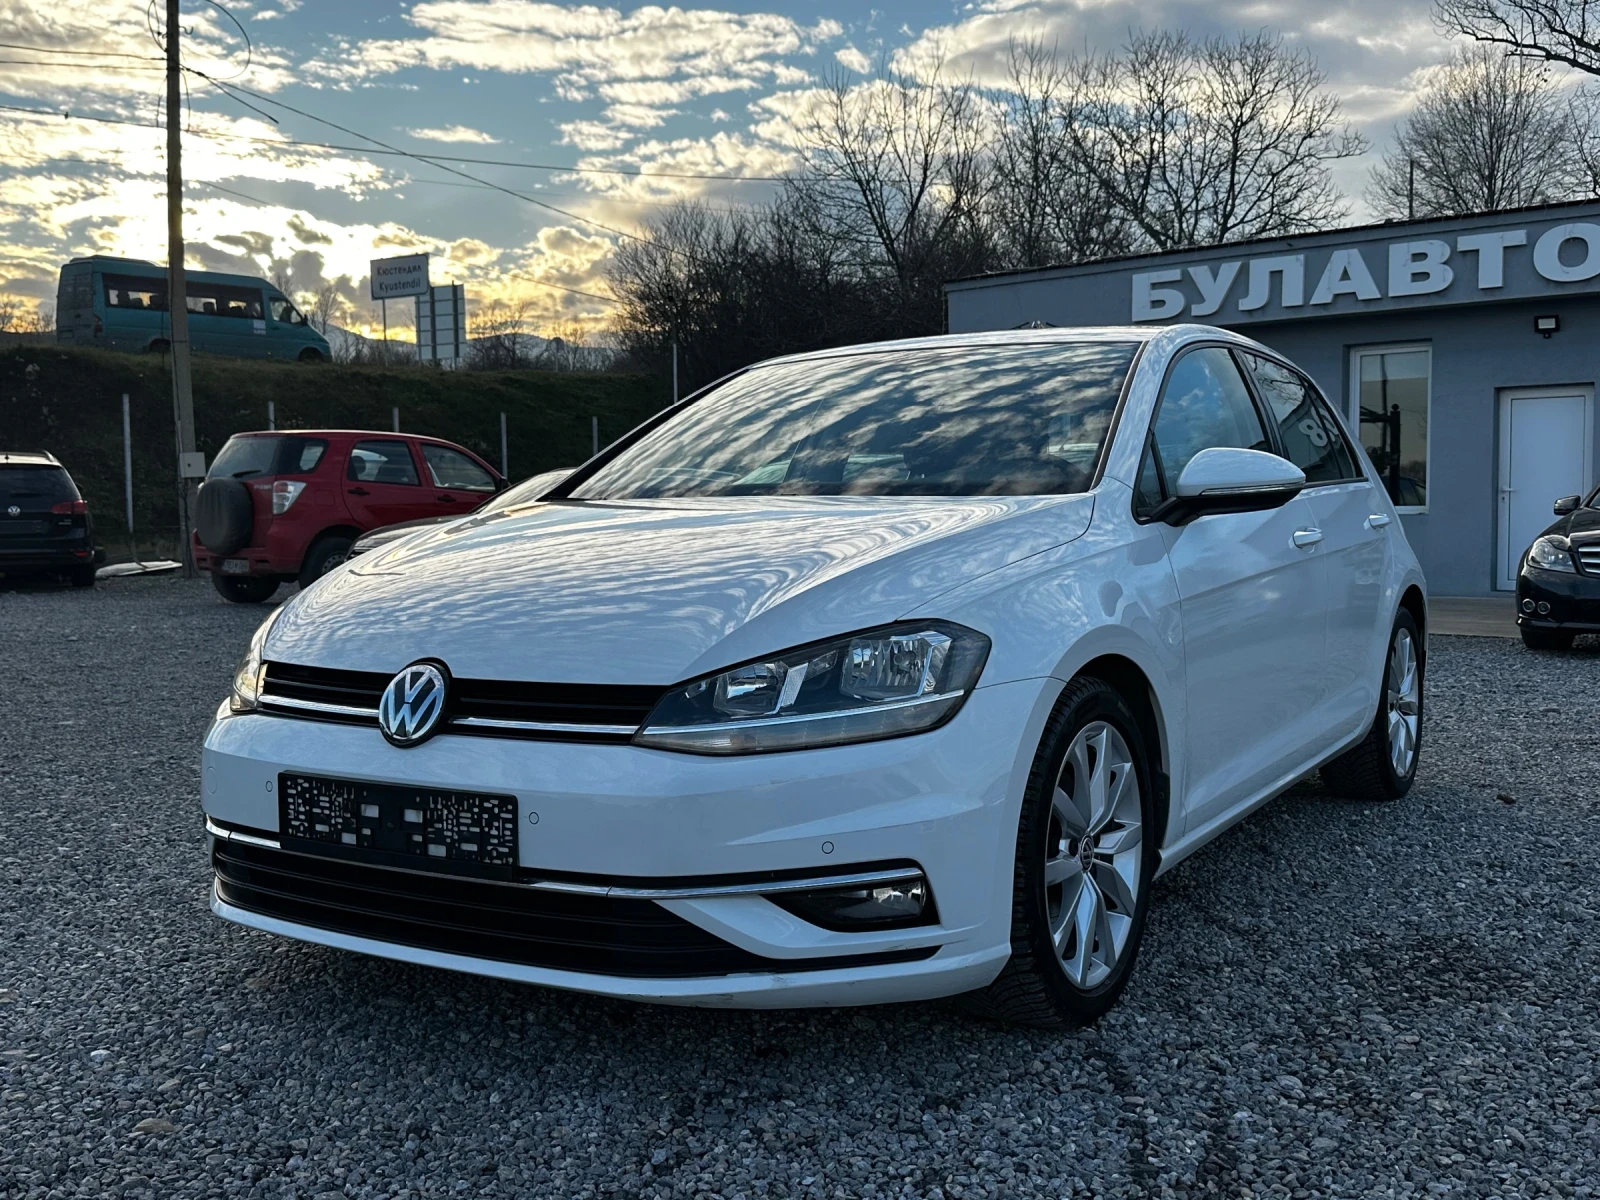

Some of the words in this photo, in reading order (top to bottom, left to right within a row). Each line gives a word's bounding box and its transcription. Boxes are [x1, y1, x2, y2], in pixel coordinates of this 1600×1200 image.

[377, 264, 422, 277] Кюстендил
[379, 278, 421, 293] Kyustendil
[1131, 222, 1600, 323] БУЛАВТО
[379, 664, 445, 740] VW
